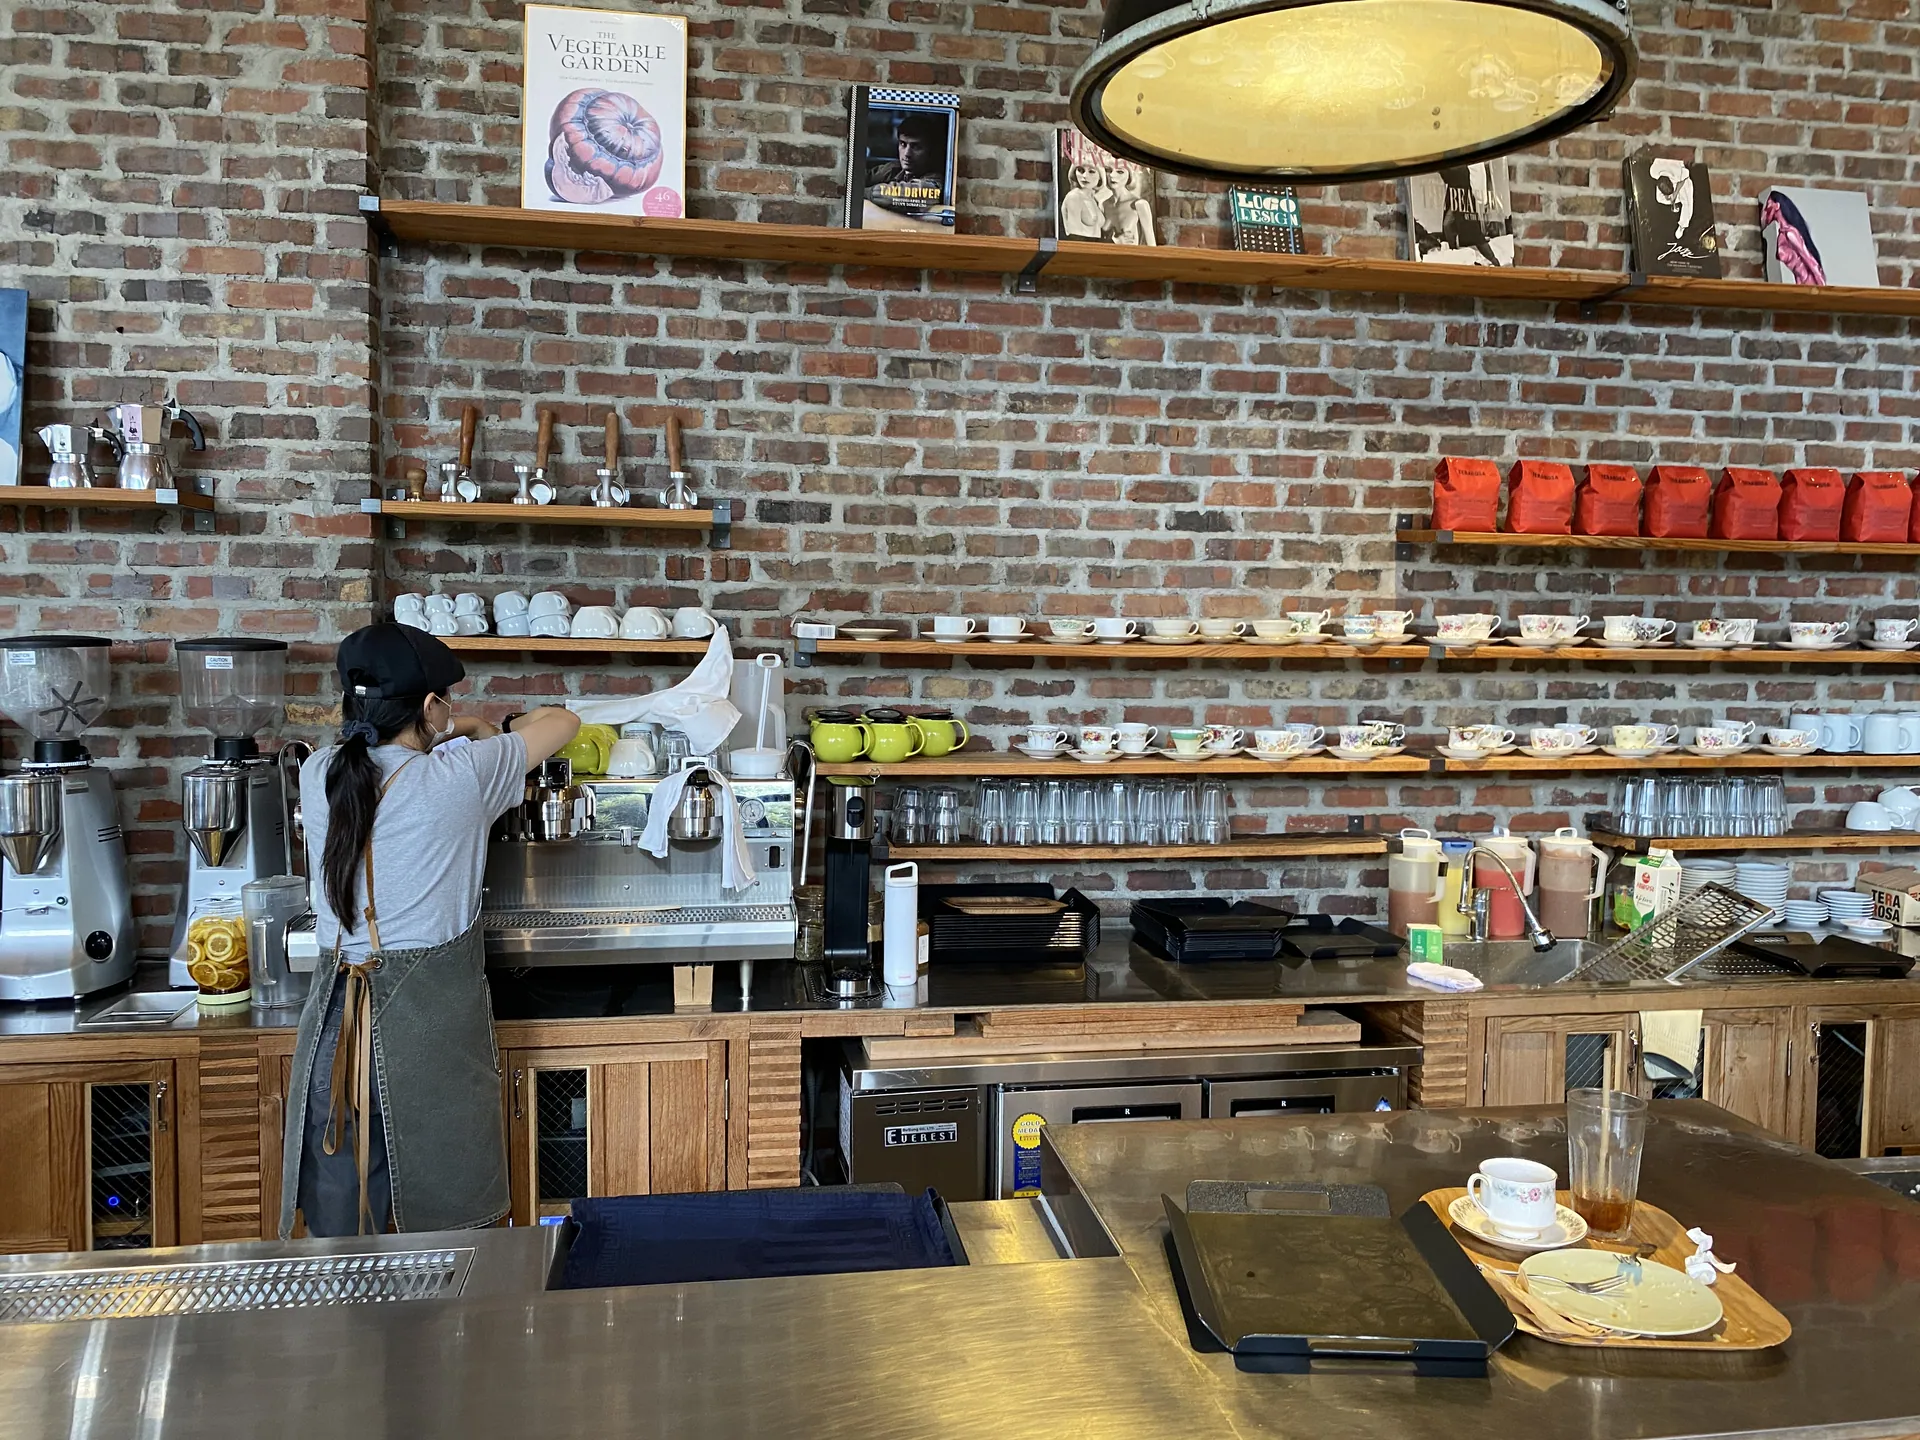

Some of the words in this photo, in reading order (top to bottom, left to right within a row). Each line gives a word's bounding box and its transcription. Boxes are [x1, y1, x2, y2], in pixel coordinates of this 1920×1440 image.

[597, 31, 617, 40] THE
[547, 33, 667, 60] VEGETABLE
[561, 54, 651, 74] GARDEN
[654, 191, 670, 203] 46
[879, 185, 901, 197] TAXI
[904, 187, 941, 199] DRIVER
[1237, 192, 1297, 213] LOGO
[1240, 208, 1299, 226] DESIGN
[1657, 242, 1702, 260] Jazz
[1871, 889, 1901, 909] TERA
[887, 1129, 955, 1145] EVEREST
